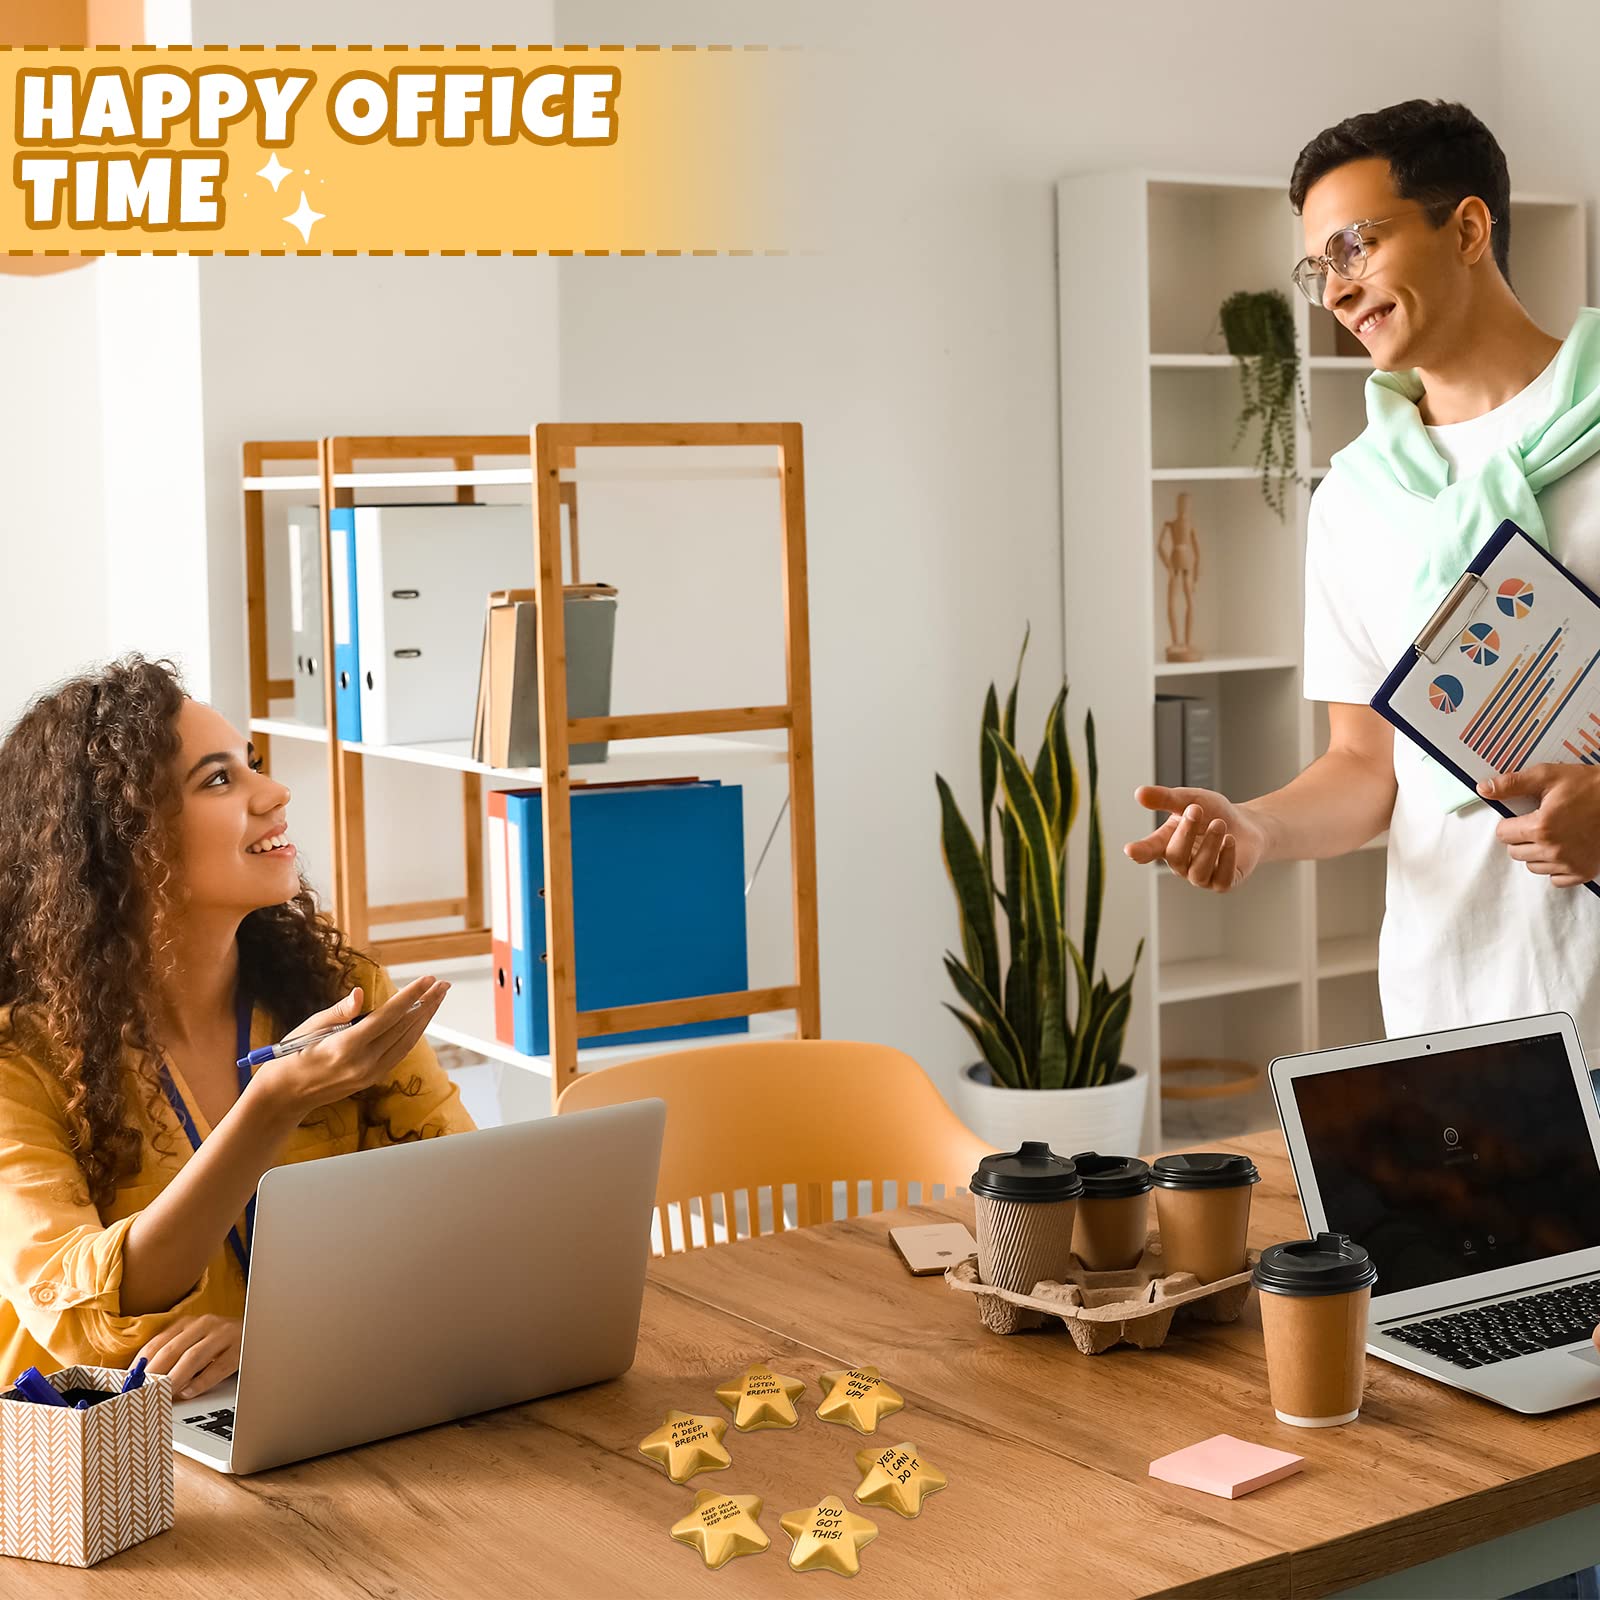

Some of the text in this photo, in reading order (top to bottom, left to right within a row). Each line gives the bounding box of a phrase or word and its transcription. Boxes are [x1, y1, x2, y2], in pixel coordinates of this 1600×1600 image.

[846, 1370, 881, 1386] NEVER
[749, 1381, 776, 1389] LISTEN
[848, 1380, 872, 1392] GIVE
[746, 1388, 781, 1396] BREATHE
[845, 1389, 865, 1400] UP!
[671, 1418, 695, 1429] TAKE
[681, 1424, 704, 1436] DEEP
[675, 1431, 709, 1448] BREATH
[876, 1448, 897, 1468] YES!
[886, 1452, 910, 1477] I CAN
[897, 1458, 920, 1484] DO IT
[701, 1500, 734, 1516] KEEP CALM
[703, 1504, 738, 1522] KEEP RELAX
[816, 1507, 843, 1517] YOU
[706, 1509, 741, 1527] KEEP GOING
[816, 1518, 843, 1528] GOT
[811, 1529, 843, 1540] THIS!
